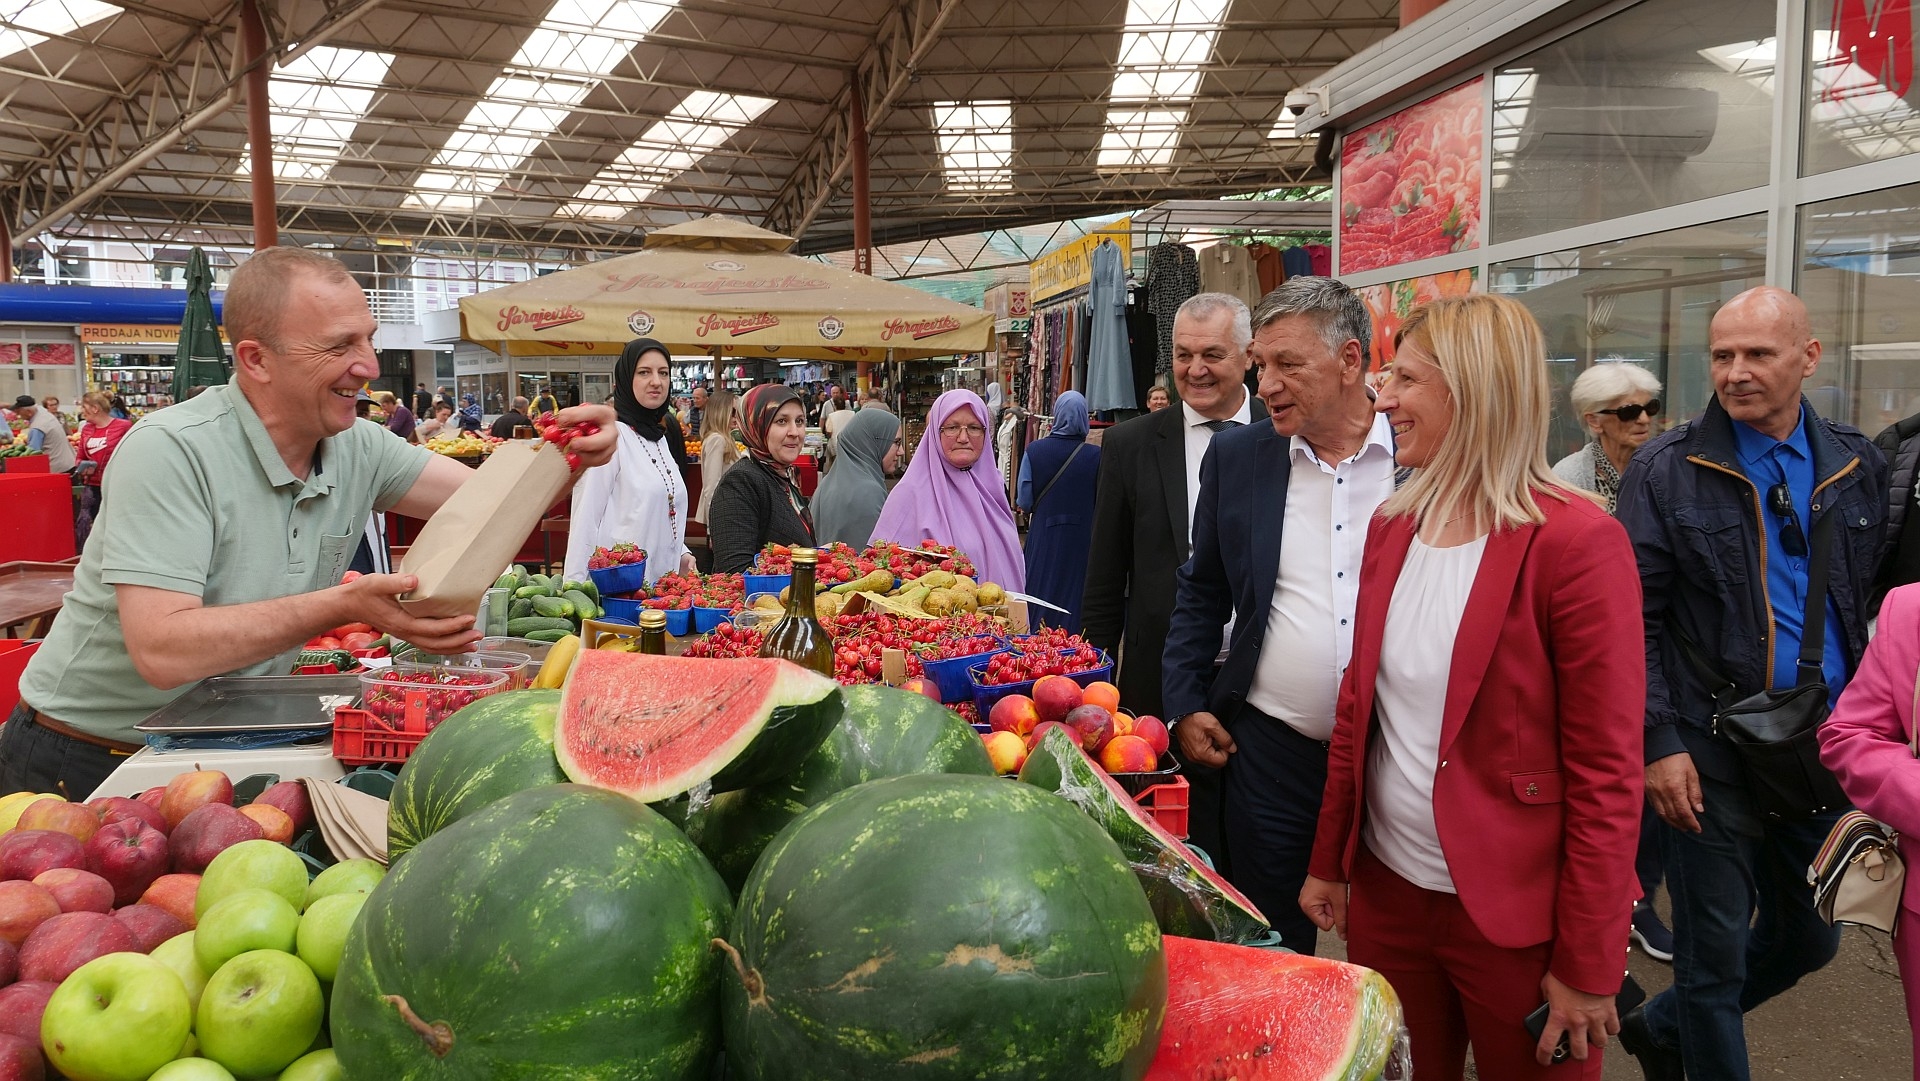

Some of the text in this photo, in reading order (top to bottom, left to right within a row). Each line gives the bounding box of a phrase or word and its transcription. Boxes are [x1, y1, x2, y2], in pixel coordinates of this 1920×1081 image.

[1062, 250, 1081, 286] shop
[497, 304, 585, 331] Sarajevsko
[696, 312, 780, 337] Sarajevsko
[881, 315, 961, 340] Sarajevsko
[1011, 320, 1029, 331] 22
[84, 327, 182, 339] PRODAJA NOVIH
